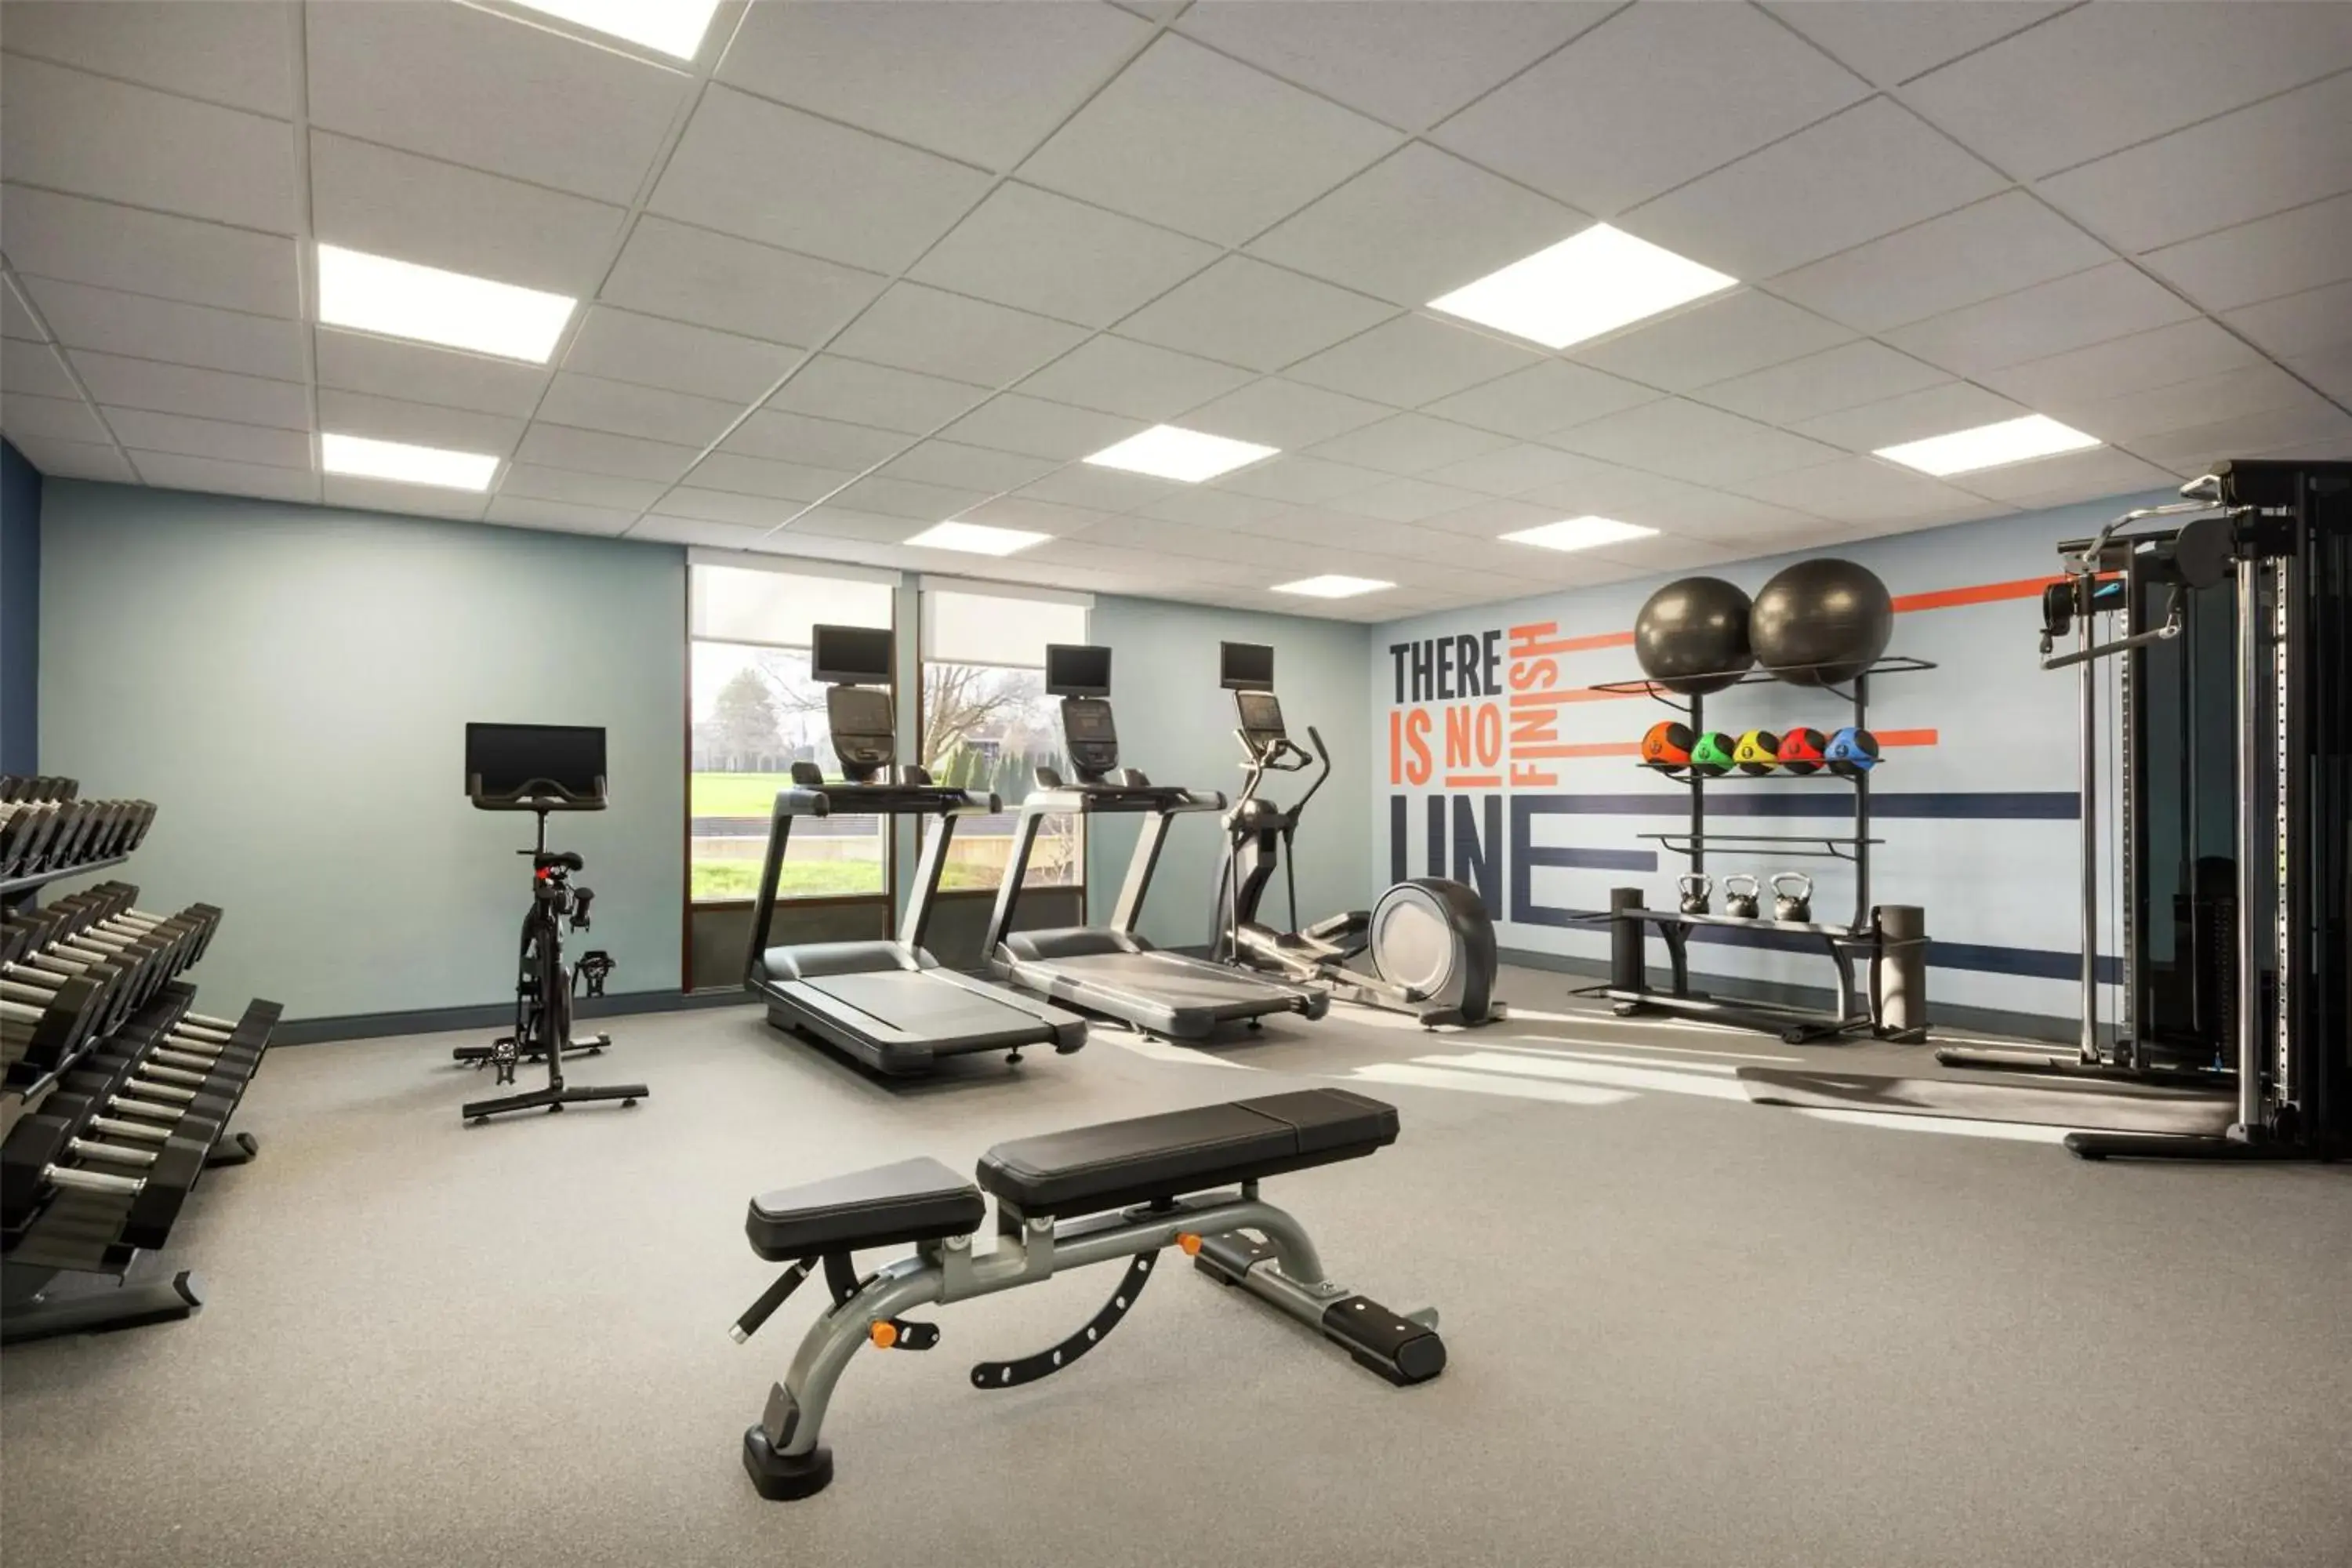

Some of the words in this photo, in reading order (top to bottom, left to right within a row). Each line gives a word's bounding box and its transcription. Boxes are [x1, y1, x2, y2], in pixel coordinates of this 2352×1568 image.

[1389, 630, 1502, 704] THERE
[1509, 622, 1559, 787] FINISH
[1390, 708, 1432, 786] IS
[1446, 702, 1502, 768] NO
